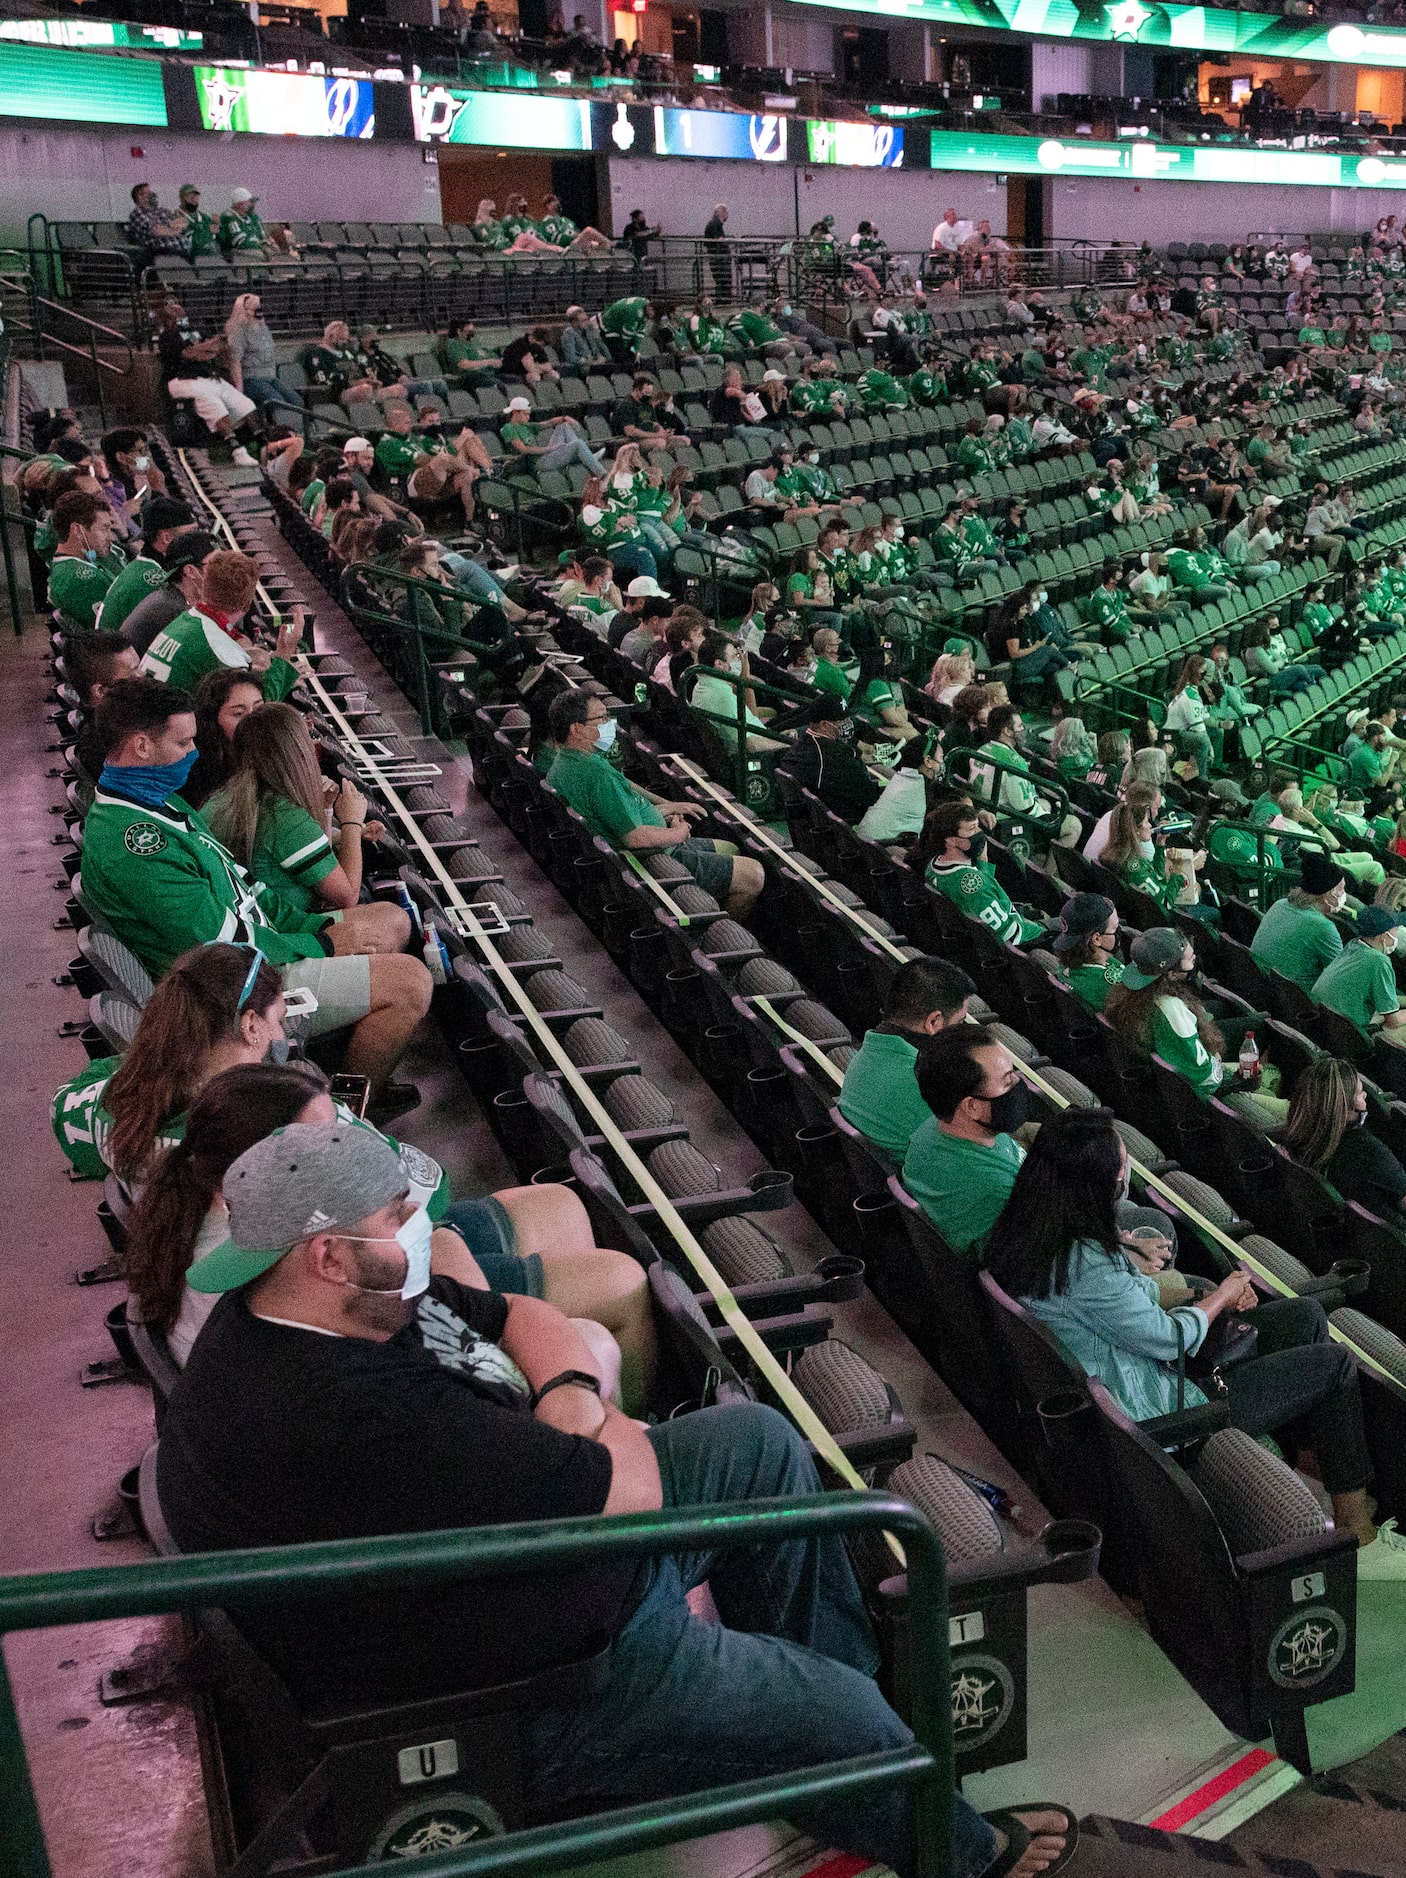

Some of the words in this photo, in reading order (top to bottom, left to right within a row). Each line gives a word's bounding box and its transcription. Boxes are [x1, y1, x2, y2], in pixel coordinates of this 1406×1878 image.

[979, 900, 1009, 931] 91
[1303, 1577, 1313, 1598] S
[956, 1617, 967, 1641] T
[418, 1746, 436, 1777] U
